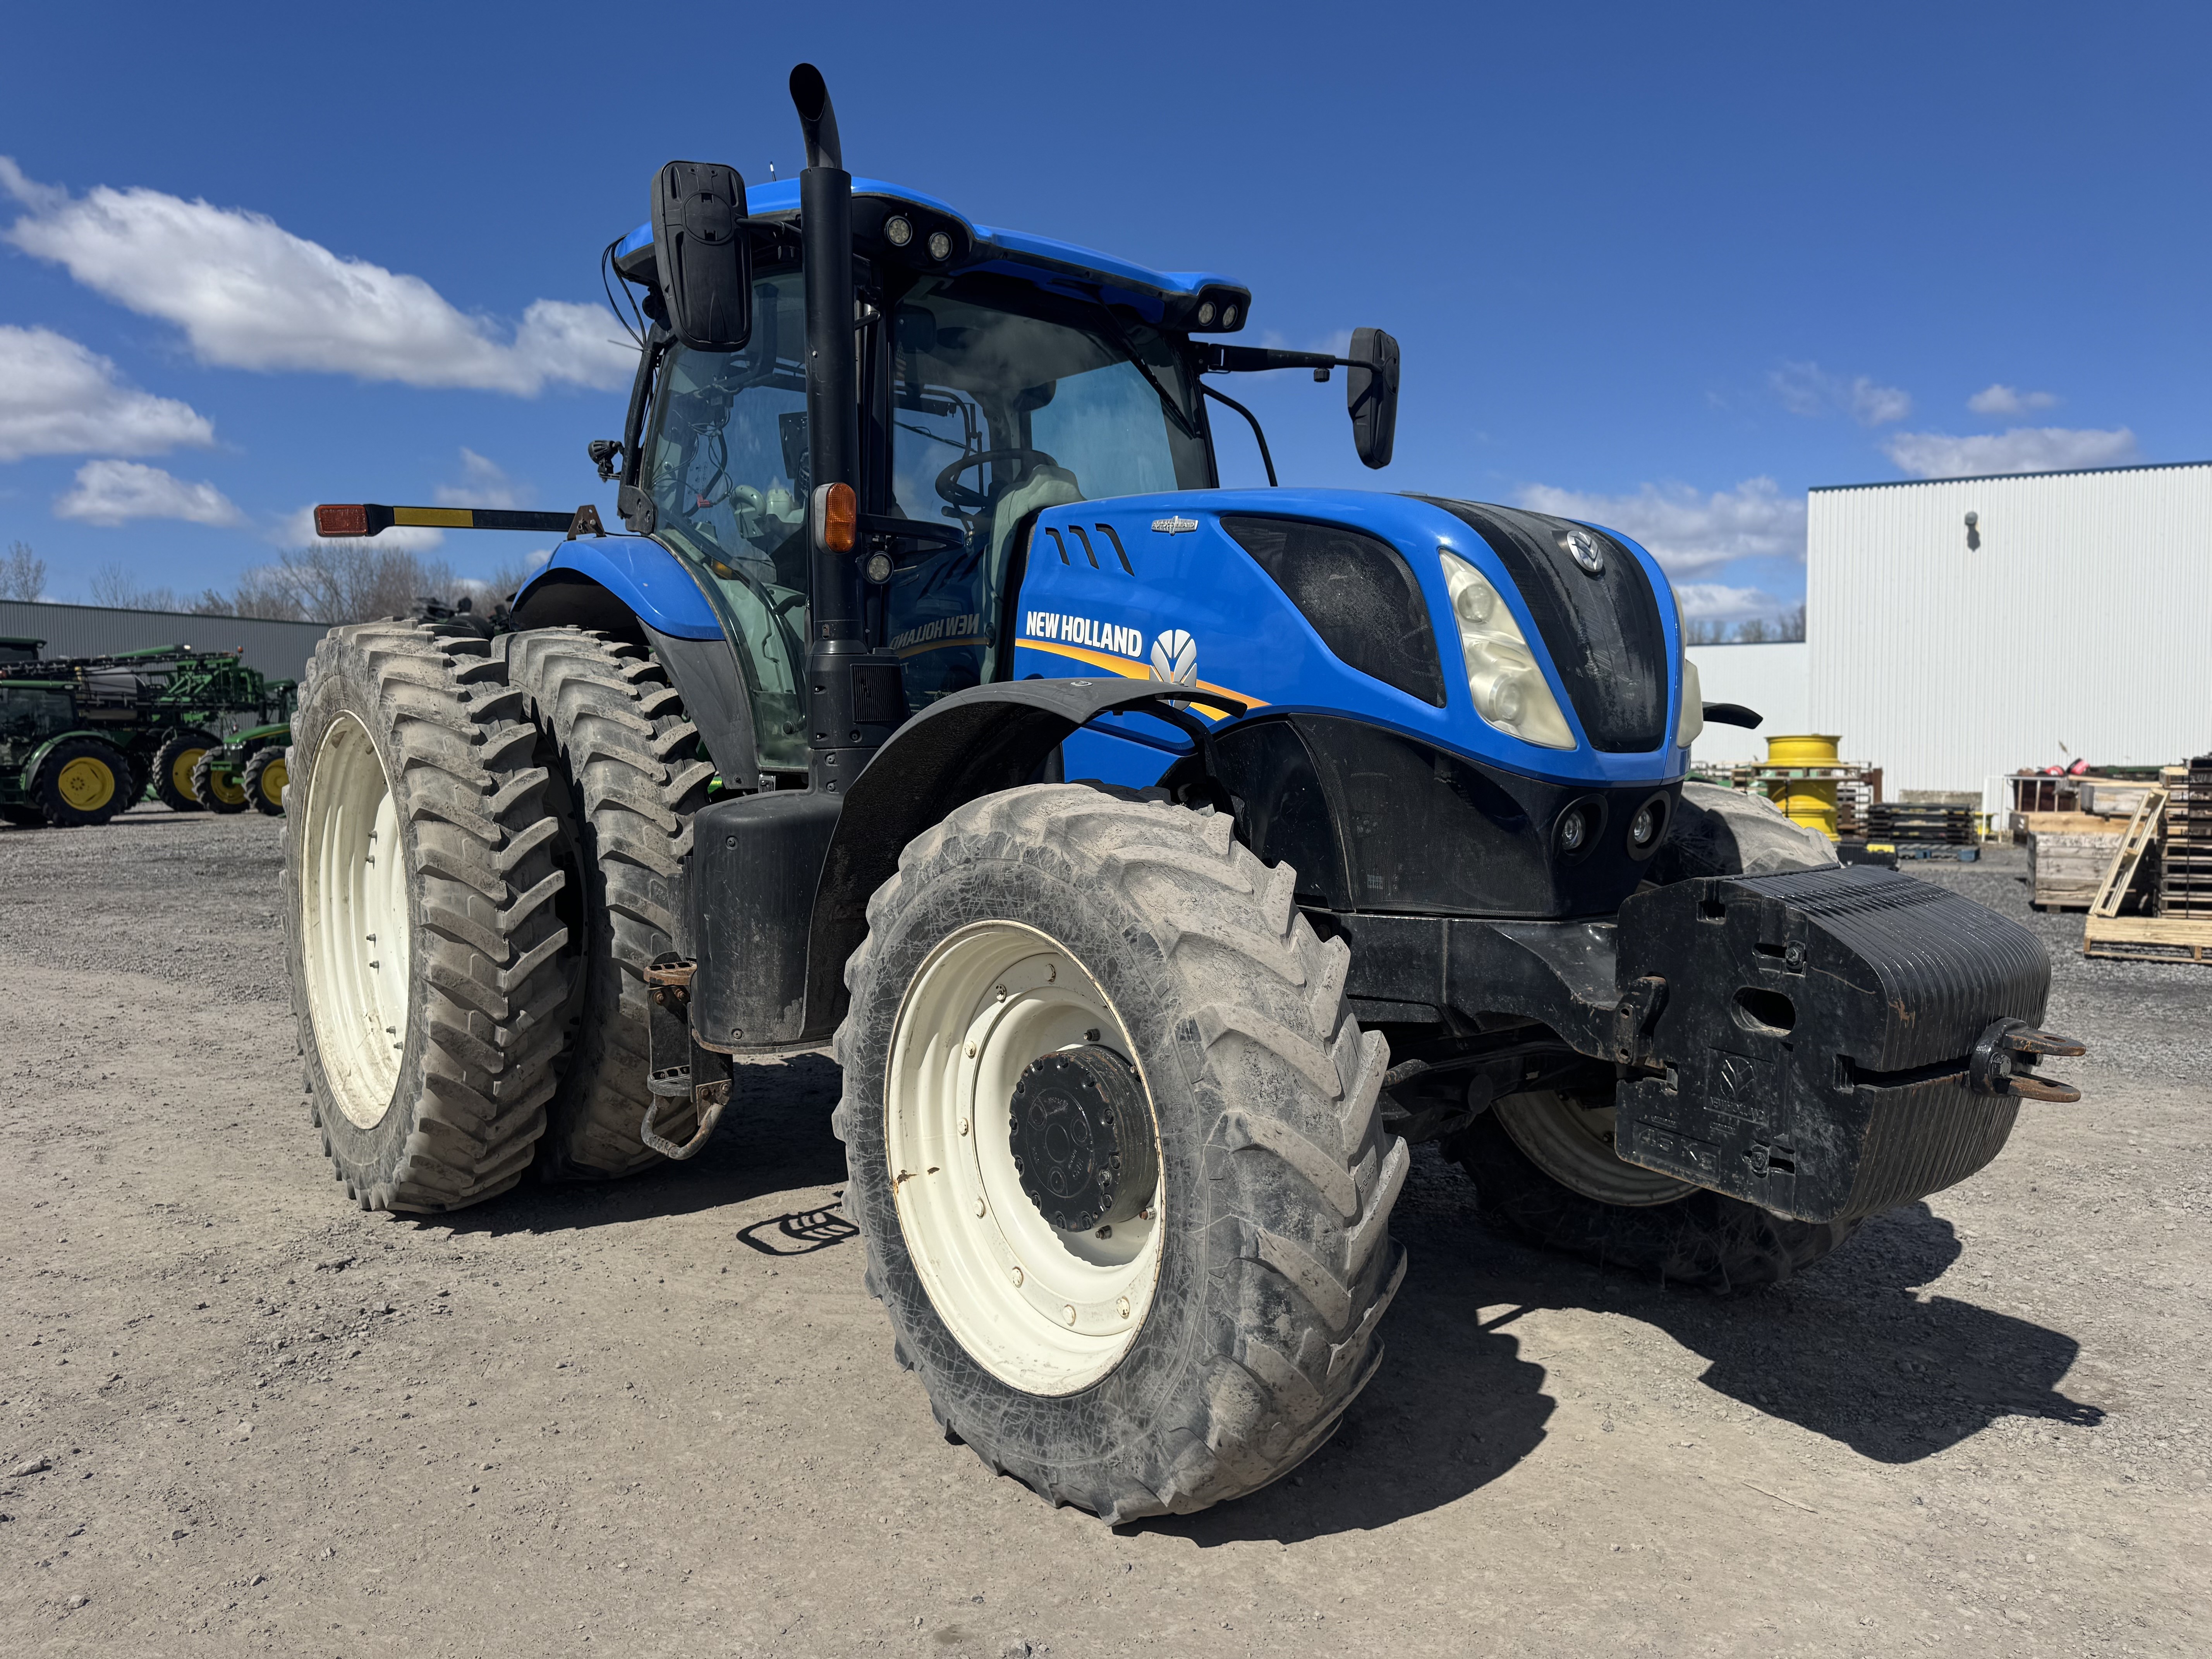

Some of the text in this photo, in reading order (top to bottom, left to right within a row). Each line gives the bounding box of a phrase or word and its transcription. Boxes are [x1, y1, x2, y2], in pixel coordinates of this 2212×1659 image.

[1026, 611, 1142, 658] NEW HOLLAND
[304, 1018, 333, 1109] MICHELIN
[1638, 1128, 1674, 1152] 45
